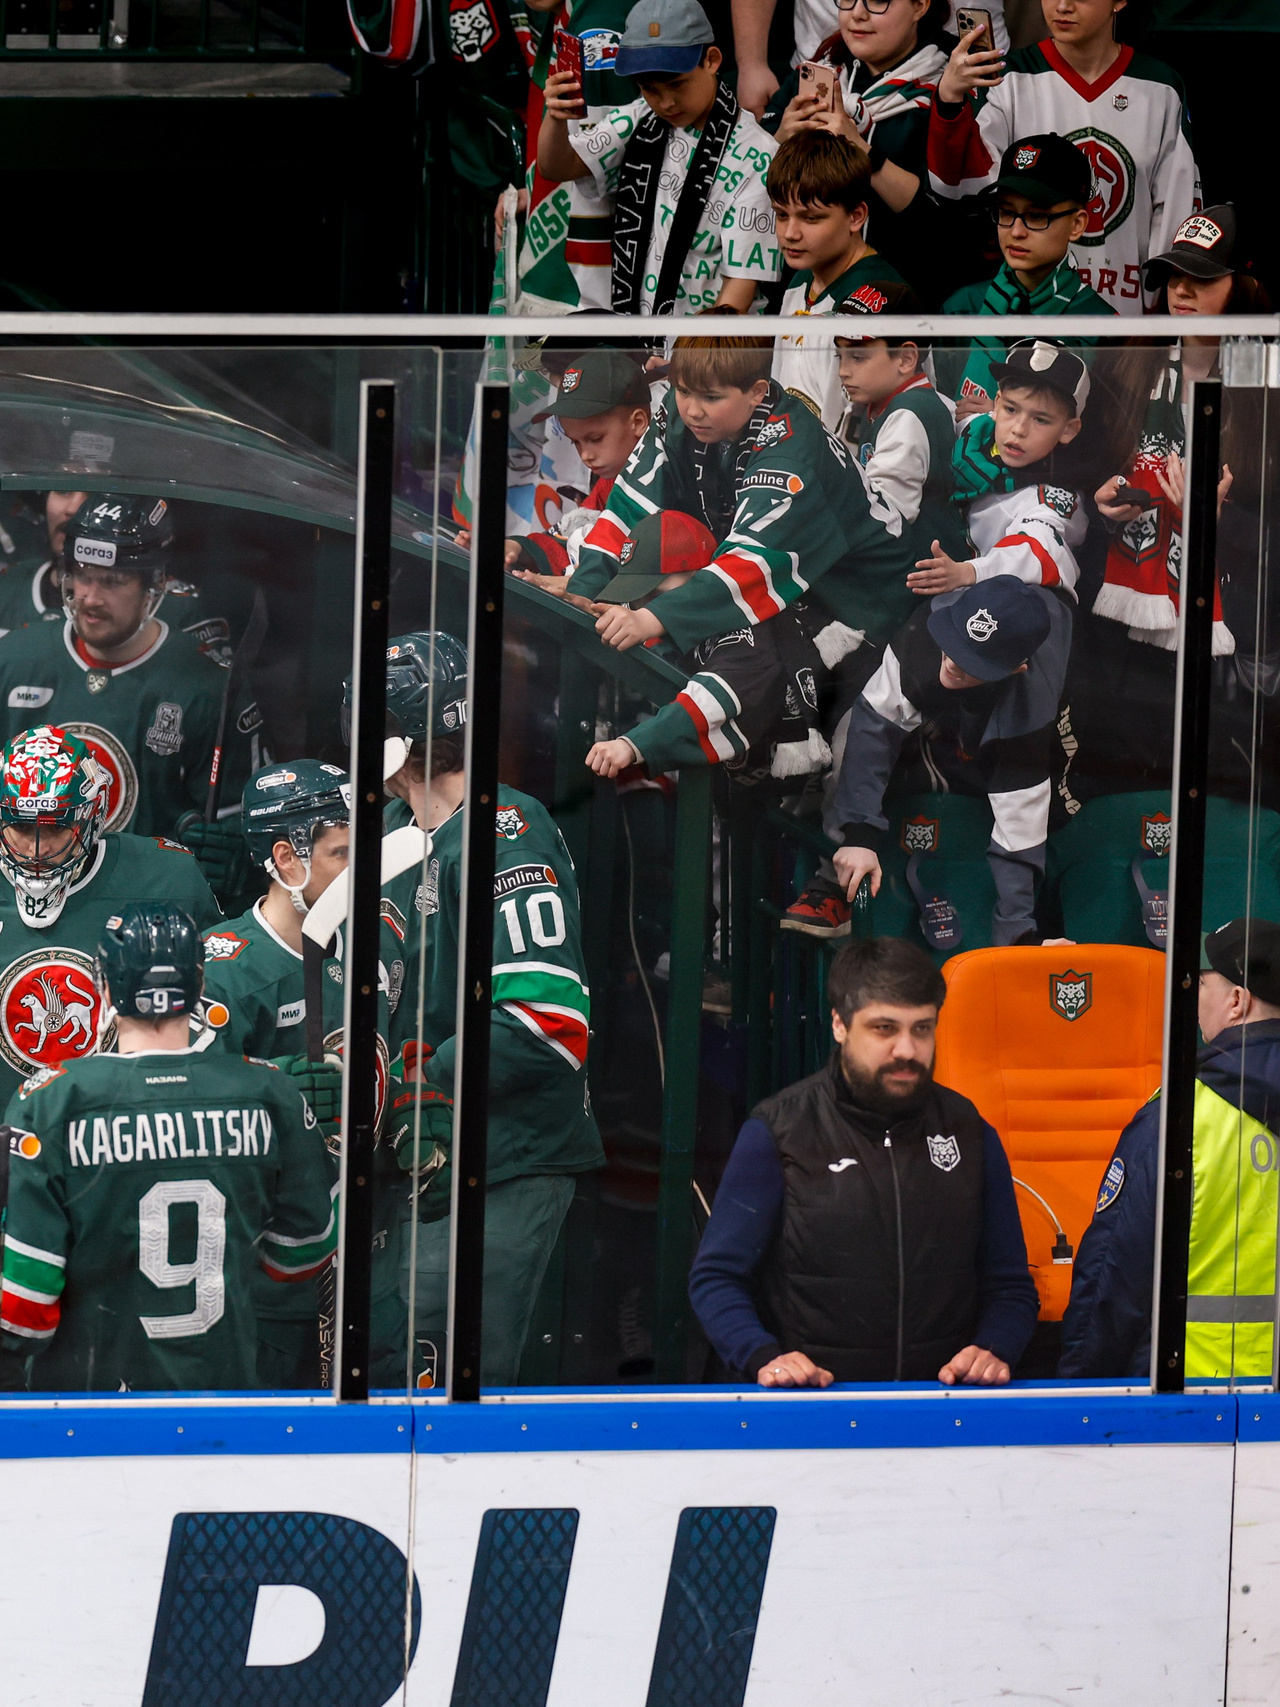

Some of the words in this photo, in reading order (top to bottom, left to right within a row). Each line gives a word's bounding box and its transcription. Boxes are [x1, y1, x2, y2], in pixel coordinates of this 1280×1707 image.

[613, 162, 652, 316] KAZA
[1192, 217, 1220, 238] BARS
[849, 284, 888, 314] BARS
[93, 502, 121, 520] 44
[76, 545, 114, 560] согаз
[971, 621, 992, 631] NHL
[16, 692, 40, 701] МИР
[210, 749, 220, 784] CCM
[17, 798, 58, 809] согаз
[250, 802, 285, 817] BAUER
[25, 895, 48, 919] 82
[499, 891, 566, 955] 10
[153, 991, 169, 1014] 9
[145, 1075, 188, 1085] КАЗАНЬ
[69, 1109, 272, 1167] KAGARLITSKY
[139, 1179, 226, 1339] 9
[320, 1362, 330, 1389] PRO
